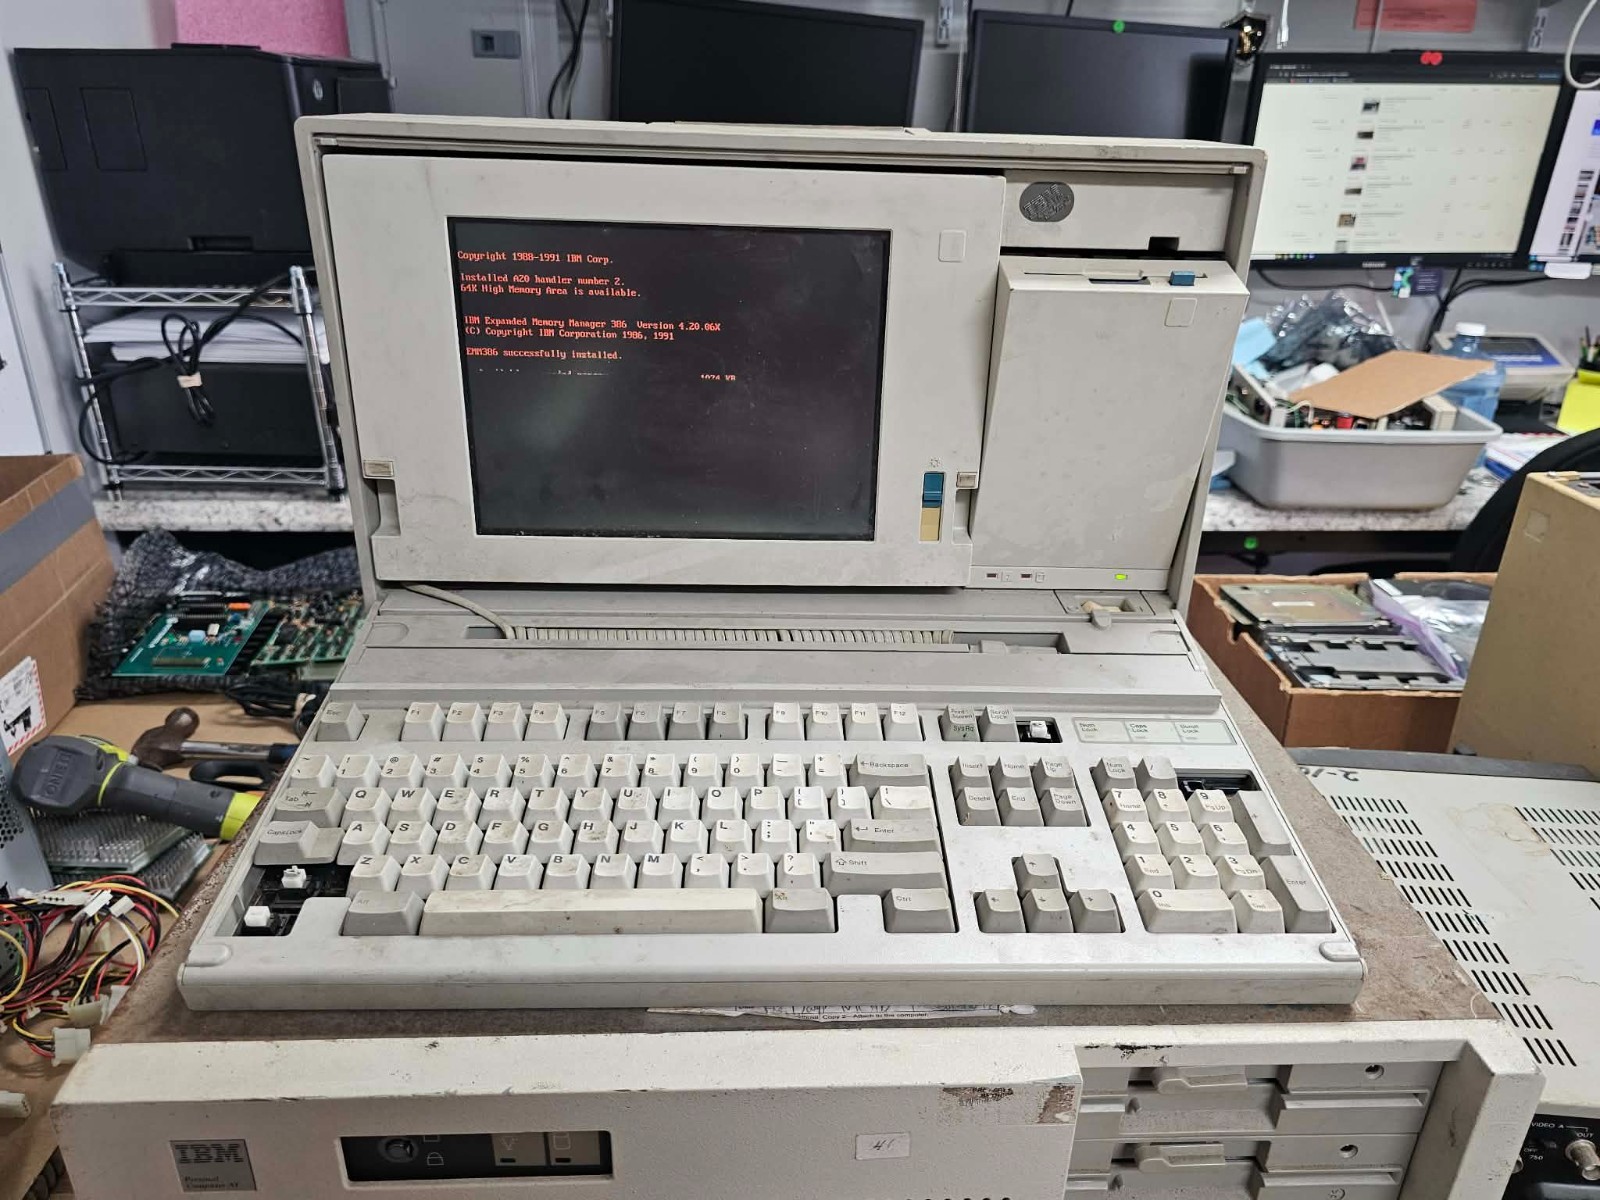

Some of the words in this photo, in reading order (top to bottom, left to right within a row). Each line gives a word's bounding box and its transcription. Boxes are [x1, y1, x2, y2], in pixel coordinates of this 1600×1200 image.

[457, 250, 507, 262] Copyright
[512, 252, 560, 262] 1988-1991
[566, 254, 582, 263] IBM
[587, 255, 614, 265] Corp.
[460, 273, 508, 282] Installed
[513, 274, 530, 283] A20
[535, 275, 572, 284] handler
[578, 276, 610, 286] number
[614, 277, 626, 286] 2.
[460, 284, 478, 292] 64K
[481, 284, 504, 295] High
[508, 285, 542, 296] Memory
[546, 287, 568, 296] Area
[574, 287, 584, 296] is
[588, 288, 642, 298] available.
[464, 316, 480, 324] IBM
[484, 316, 527, 327] Expanded
[532, 318, 565, 328] Memory
[568, 318, 606, 330] Manager
[610, 320, 628, 328] 386
[636, 320, 674, 330] Version
[678, 322, 721, 332] 4.20.06X
[464, 326, 481, 336] (C)
[486, 327, 534, 338] Copyright
[539, 328, 554, 337] IBM
[558, 329, 618, 340] Corporation
[622, 330, 648, 340] 1986,
[653, 332, 674, 340] 1991
[466, 347, 498, 356] EMM386
[503, 348, 567, 360] successfully
[572, 350, 622, 360] installed.
[355, 790, 367, 798] Q
[444, 790, 455, 798] E
[624, 789, 633, 797] U
[712, 789, 722, 797] O
[352, 824, 363, 832] A
[538, 823, 549, 831] G
[583, 822, 594, 830] H
[674, 822, 684, 830] K
[1170, 824, 1179, 832] 5
[360, 856, 373, 864] Z
[410, 856, 422, 864] X
[507, 856, 517, 864] V
[553, 856, 563, 864] B
[648, 855, 660, 863] M
[175, 1144, 244, 1164] IBM
